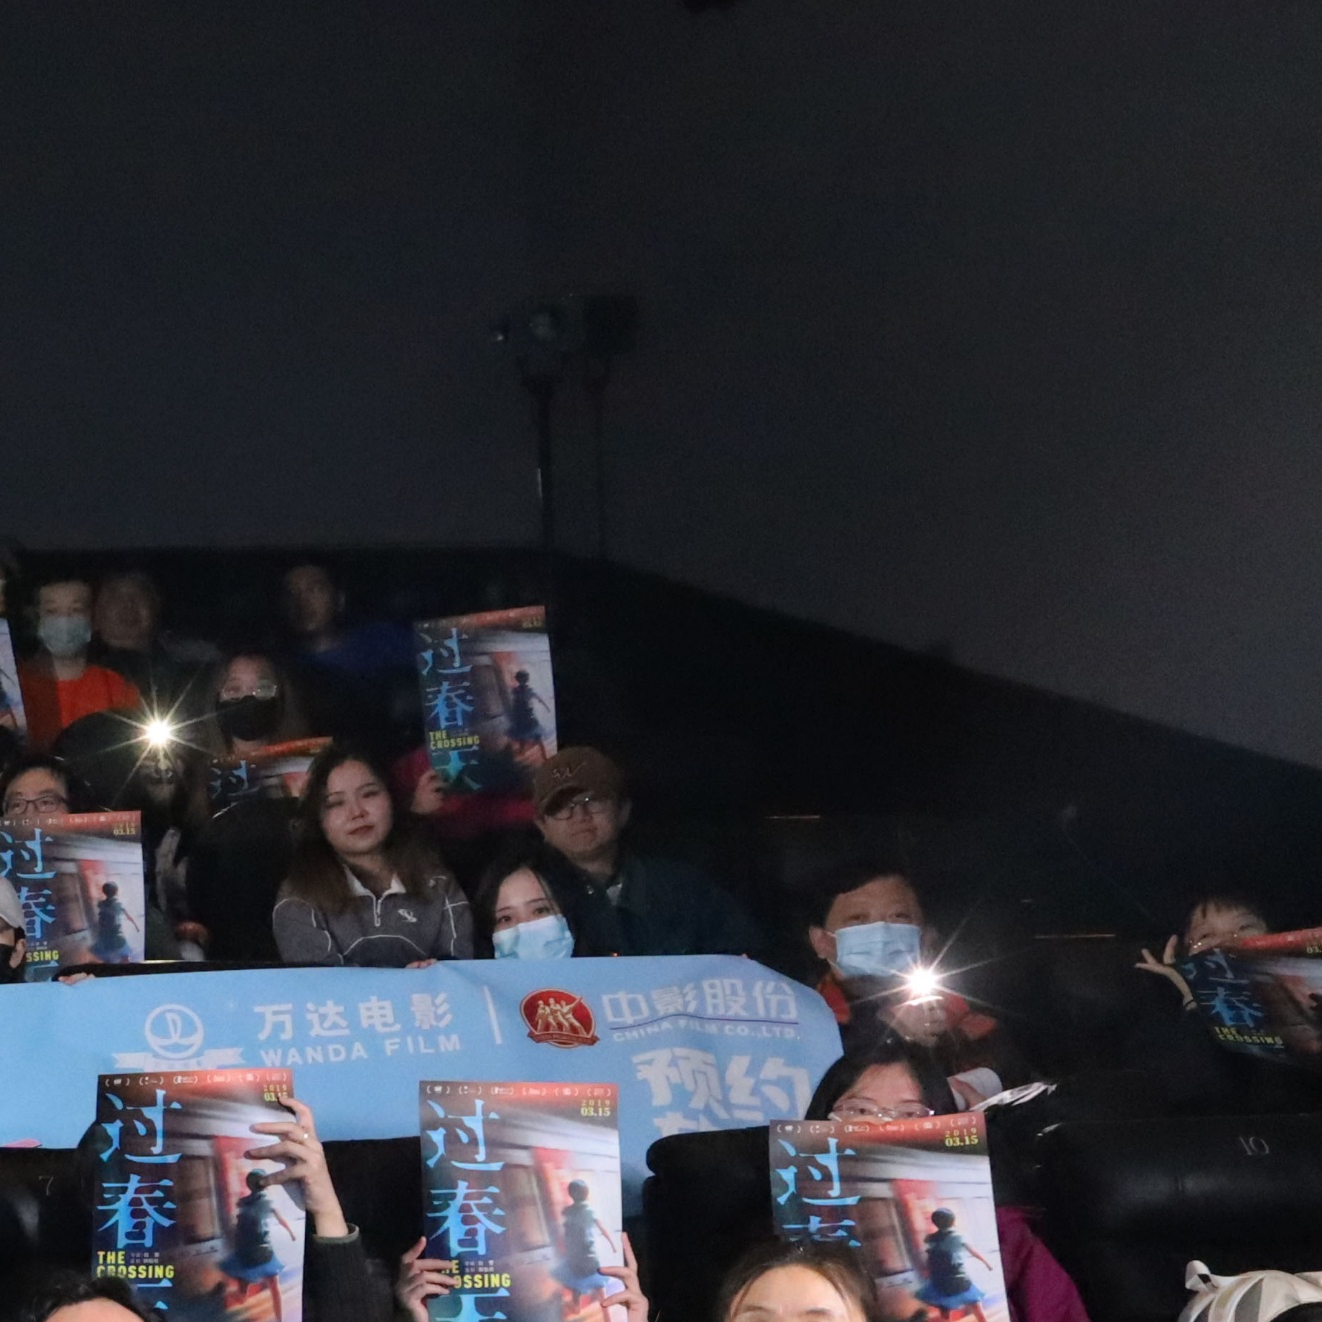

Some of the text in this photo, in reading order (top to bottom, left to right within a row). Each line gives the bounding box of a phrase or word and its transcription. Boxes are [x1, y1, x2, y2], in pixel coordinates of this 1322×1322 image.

[26, 949, 60, 962] SSING
[601, 978, 799, 1025] 中影股份
[253, 991, 455, 1042] 万达电影
[612, 1021, 674, 1043] CHINA
[260, 1033, 462, 1068] WANDA FILM
[631, 1046, 812, 1121] 预约
[579, 1106, 612, 1118] 03.15
[944, 1136, 980, 1148] 03.15
[945, 1128, 978, 1139] 2019
[1238, 1135, 1270, 1156] 10
[38, 1175, 55, 1197] 7
[96, 1250, 126, 1264] THE
[96, 1264, 176, 1279] CROSSING
[453, 1272, 512, 1289] OSSING
